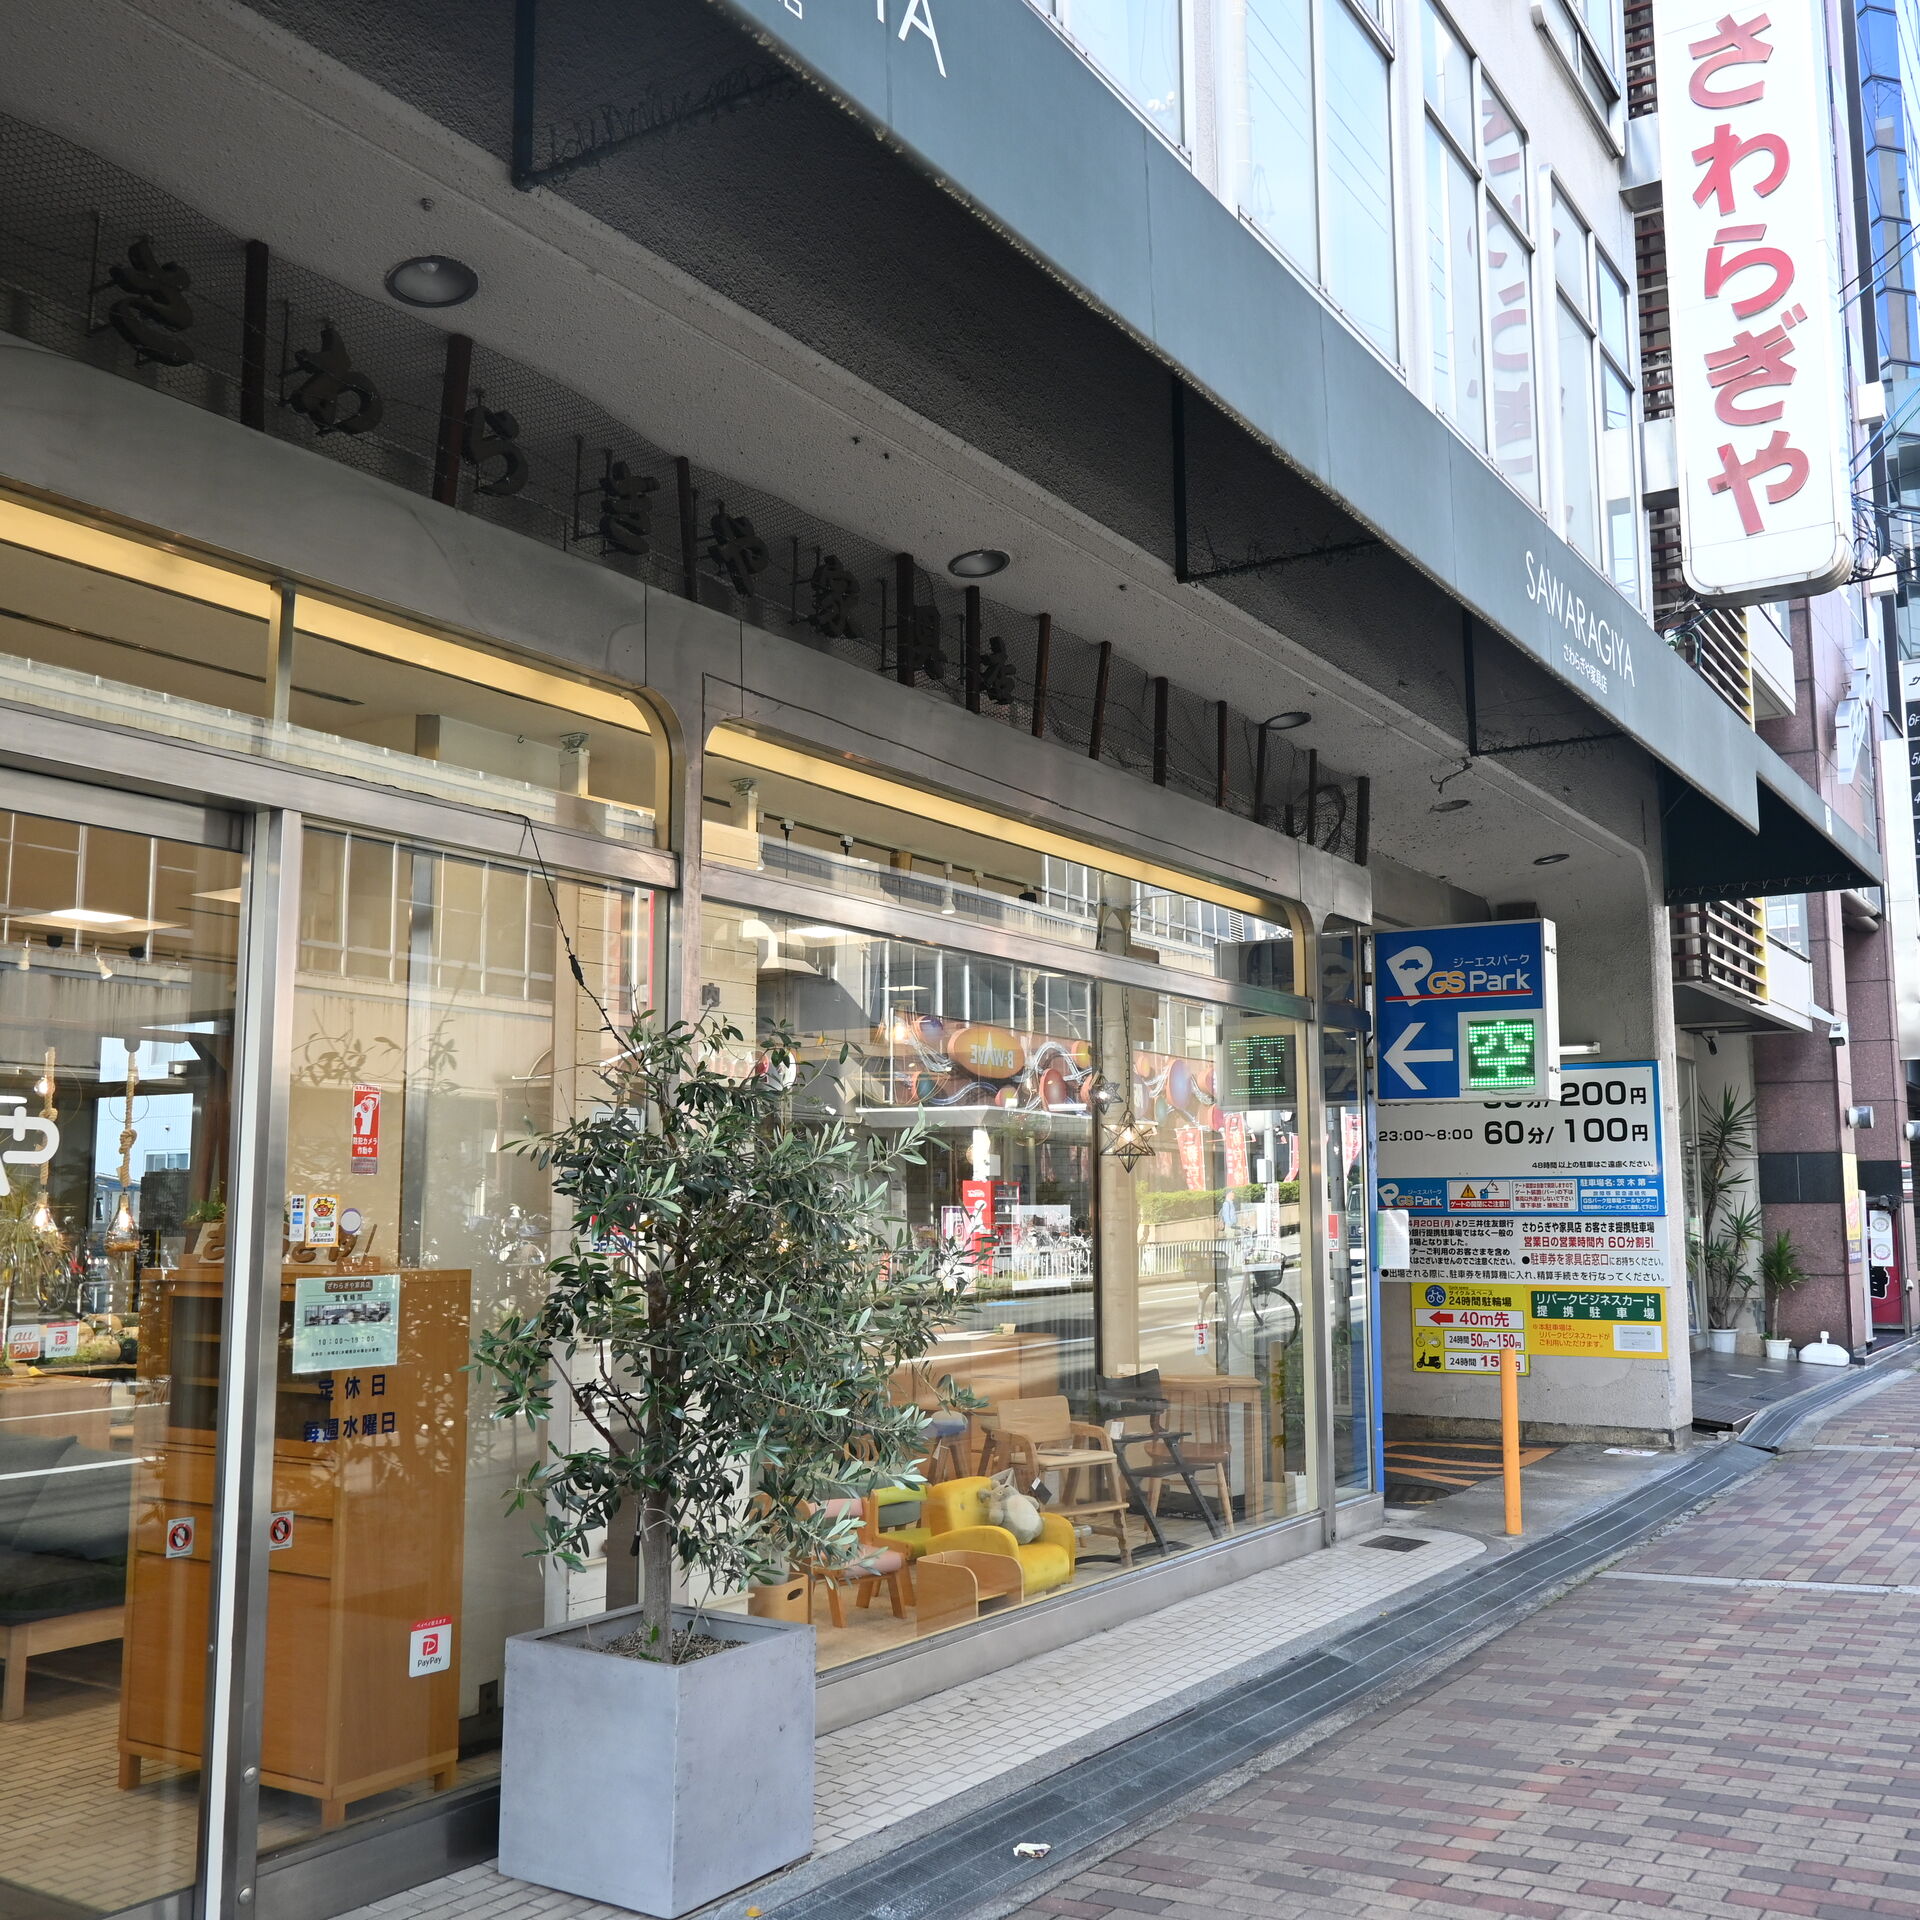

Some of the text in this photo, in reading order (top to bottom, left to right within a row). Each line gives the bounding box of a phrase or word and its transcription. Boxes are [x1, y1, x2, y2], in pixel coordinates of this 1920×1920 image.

[1688, 12, 1808, 536] さわらぎや
[1525, 550, 1636, 688] SAWARAGIYA
[1563, 643, 1609, 694] さわらぎや家具店
[1452, 953, 1530, 968] ジーエスパーク
[1468, 1020, 1536, 1087] 空
[1560, 1080, 1647, 1107] 200円
[1564, 1117, 1649, 1143] 100円
[353, 1137, 378, 1146] 防犯カメラ
[357, 1147, 373, 1155] 作動中
[1409, 1229, 1514, 1238] 銀行提携駐車場ではなく一般の
[1522, 1222, 1582, 1233] さわらぎや家具店
[1524, 1236, 1654, 1248] 営業日の営業時間内 60分割引
[1448, 1297, 1512, 1307] 24時間駐輪場
[1536, 1293, 1656, 1307] リパークビジネスカード
[1459, 1311, 1510, 1328] 40m先
[1539, 1331, 1610, 1340] リパークビジネスカードが
[14, 1344, 34, 1355] PAY
[318, 1373, 386, 1401] 定休日
[303, 1411, 396, 1443] 毎週水曜日
[417, 1655, 443, 1668] PayPay
